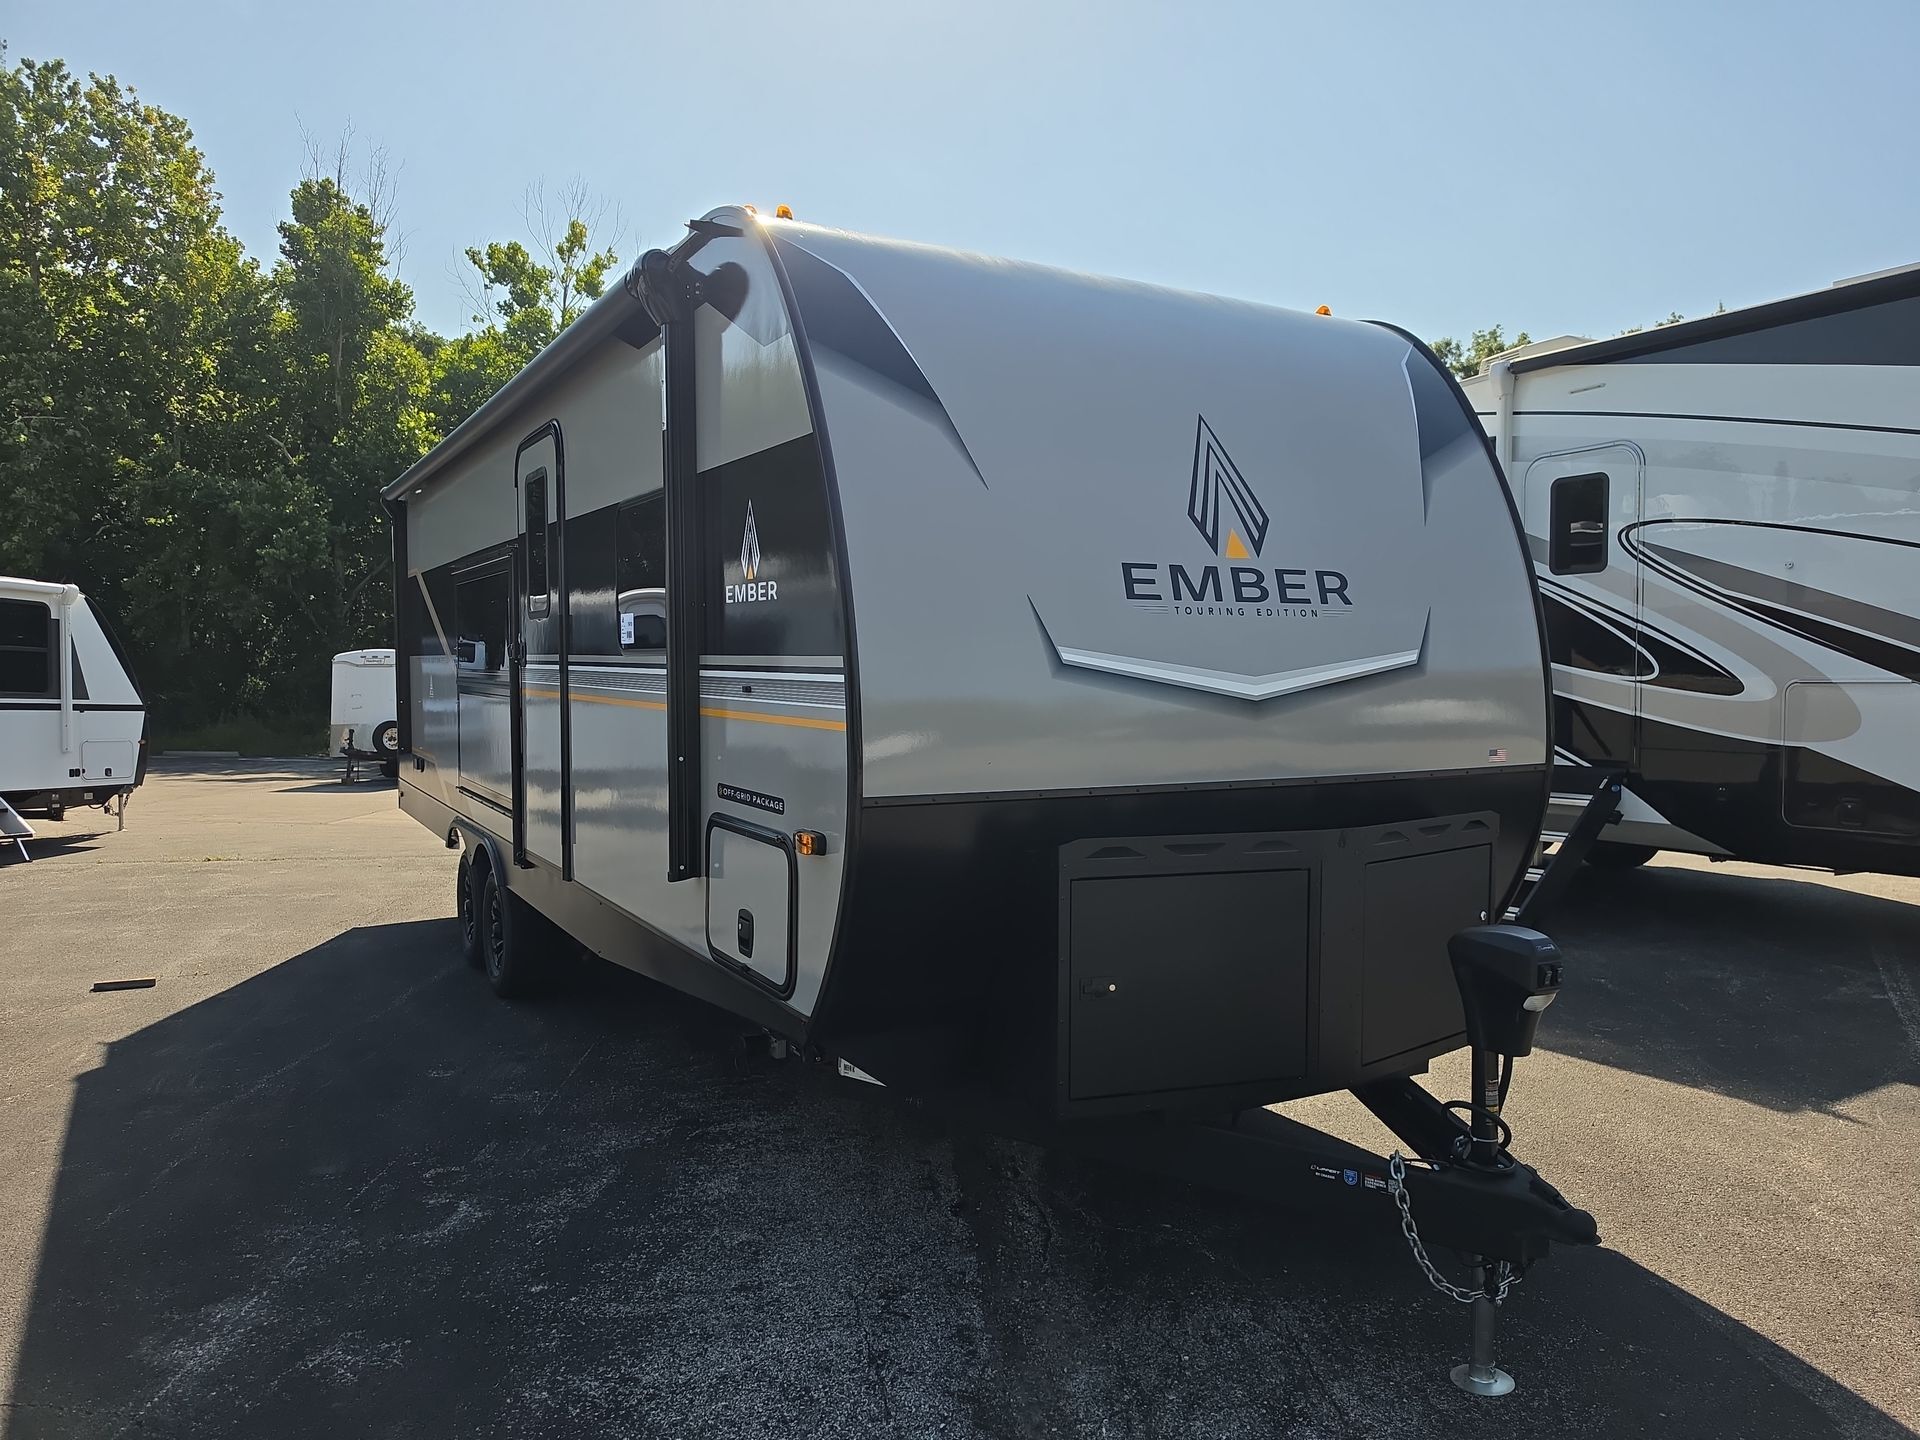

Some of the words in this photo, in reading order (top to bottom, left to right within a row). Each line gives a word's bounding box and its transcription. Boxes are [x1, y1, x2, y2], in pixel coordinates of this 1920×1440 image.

[725, 580, 778, 604] EMBER
[1121, 562, 1353, 605] EMBER
[1174, 606, 1246, 617] TOURING
[1256, 608, 1319, 618] EDITION
[722, 787, 751, 802] OFF-GRID
[752, 796, 784, 811] PACKAGE
